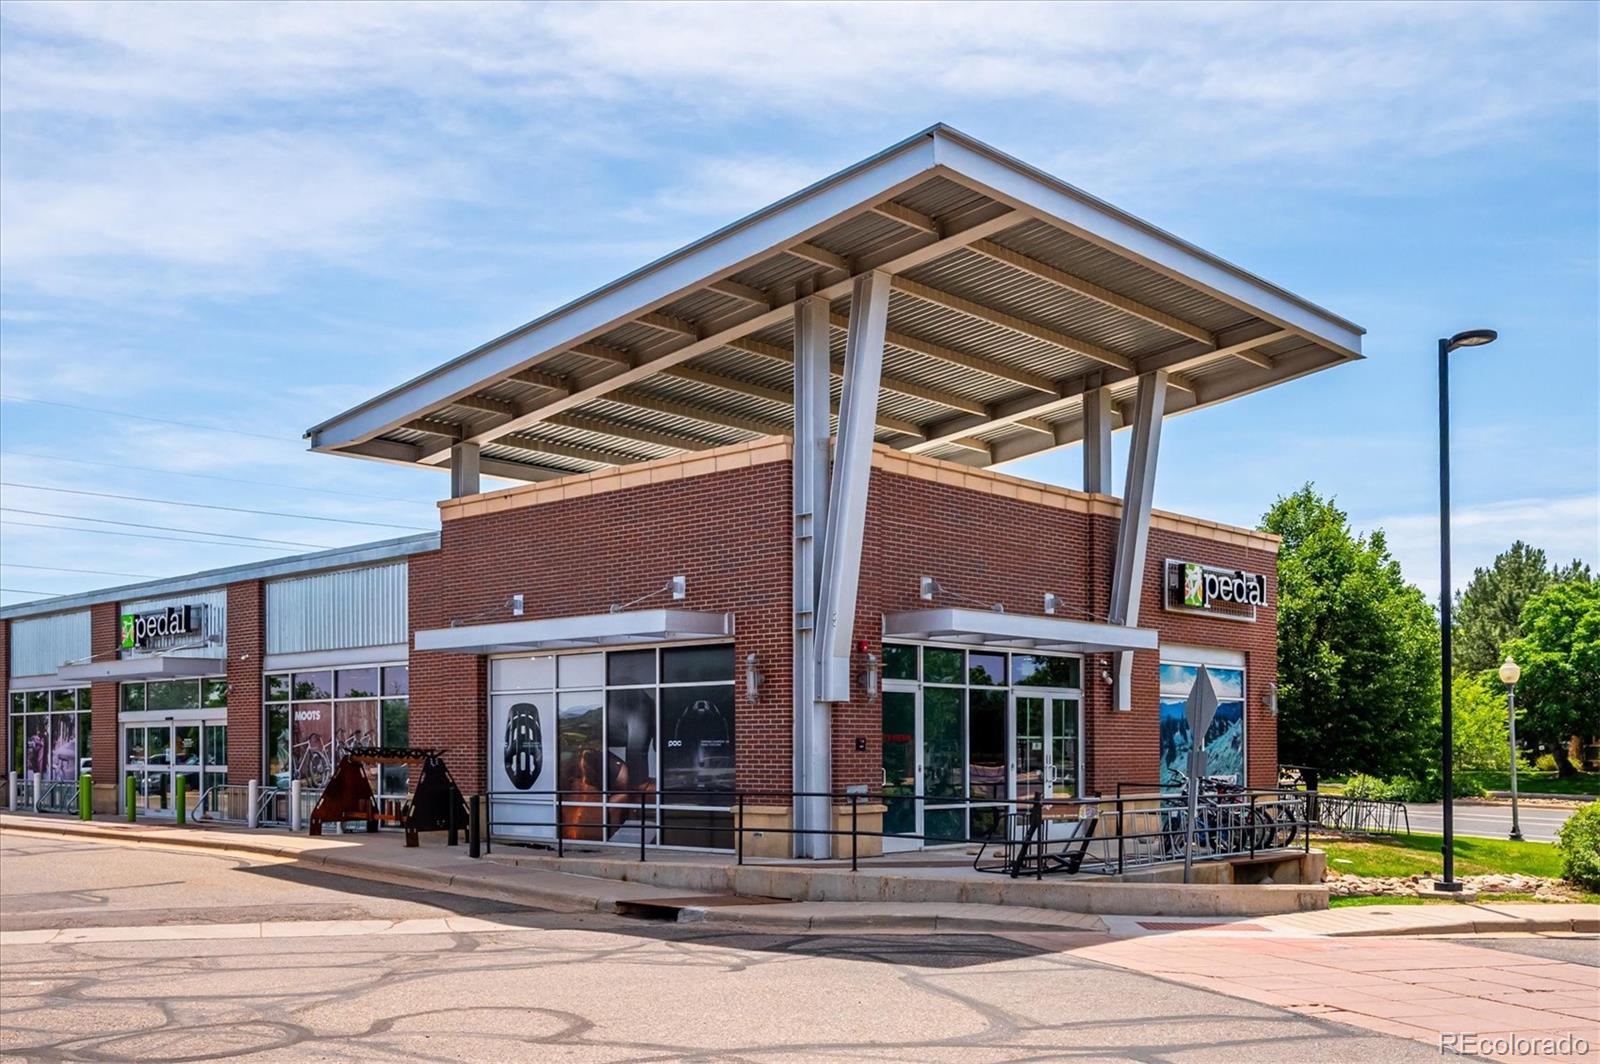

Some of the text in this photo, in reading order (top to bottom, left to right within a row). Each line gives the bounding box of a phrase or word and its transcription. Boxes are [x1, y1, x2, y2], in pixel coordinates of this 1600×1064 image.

[1203, 571, 1268, 608] pedal
[135, 607, 186, 647] pedal
[294, 710, 321, 721] MOOTS
